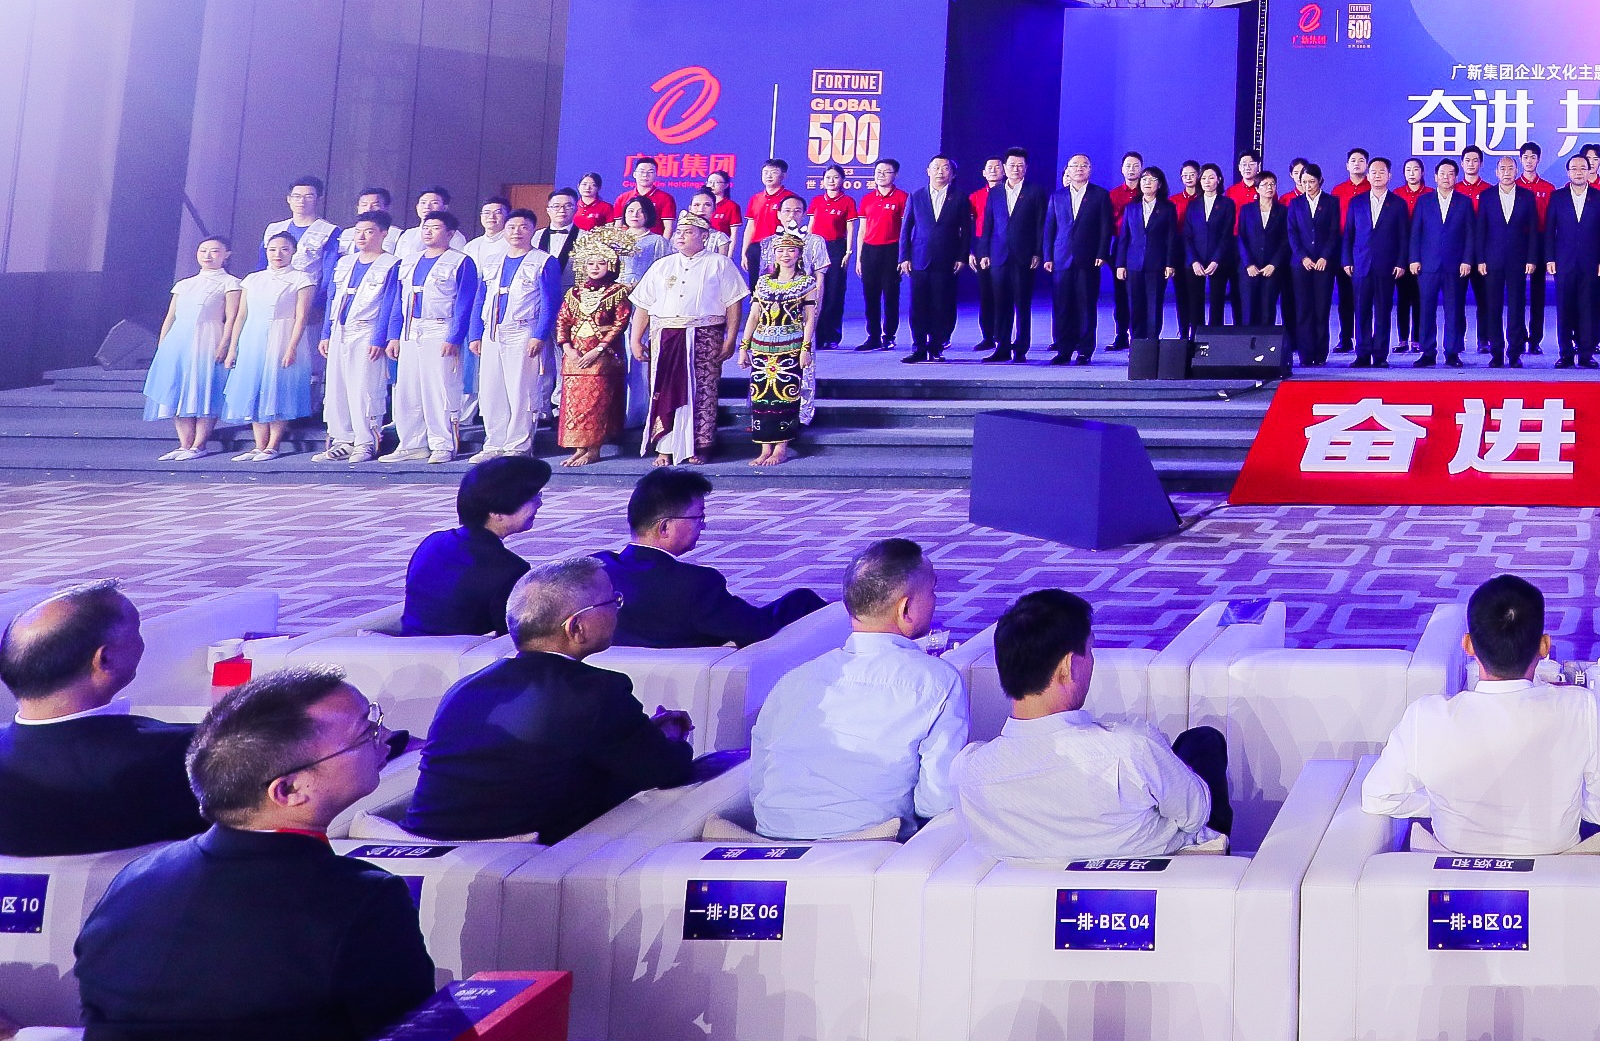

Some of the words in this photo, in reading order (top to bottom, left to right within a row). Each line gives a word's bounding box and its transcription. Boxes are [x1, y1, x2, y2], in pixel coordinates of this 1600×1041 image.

[1348, 20, 1372, 39] 500
[817, 74, 877, 90] FORTUNE
[810, 98, 881, 112] GLOBAL
[1407, 89, 1535, 156] 奋进
[807, 113, 882, 165] 500
[1302, 398, 1576, 474] 奋进
